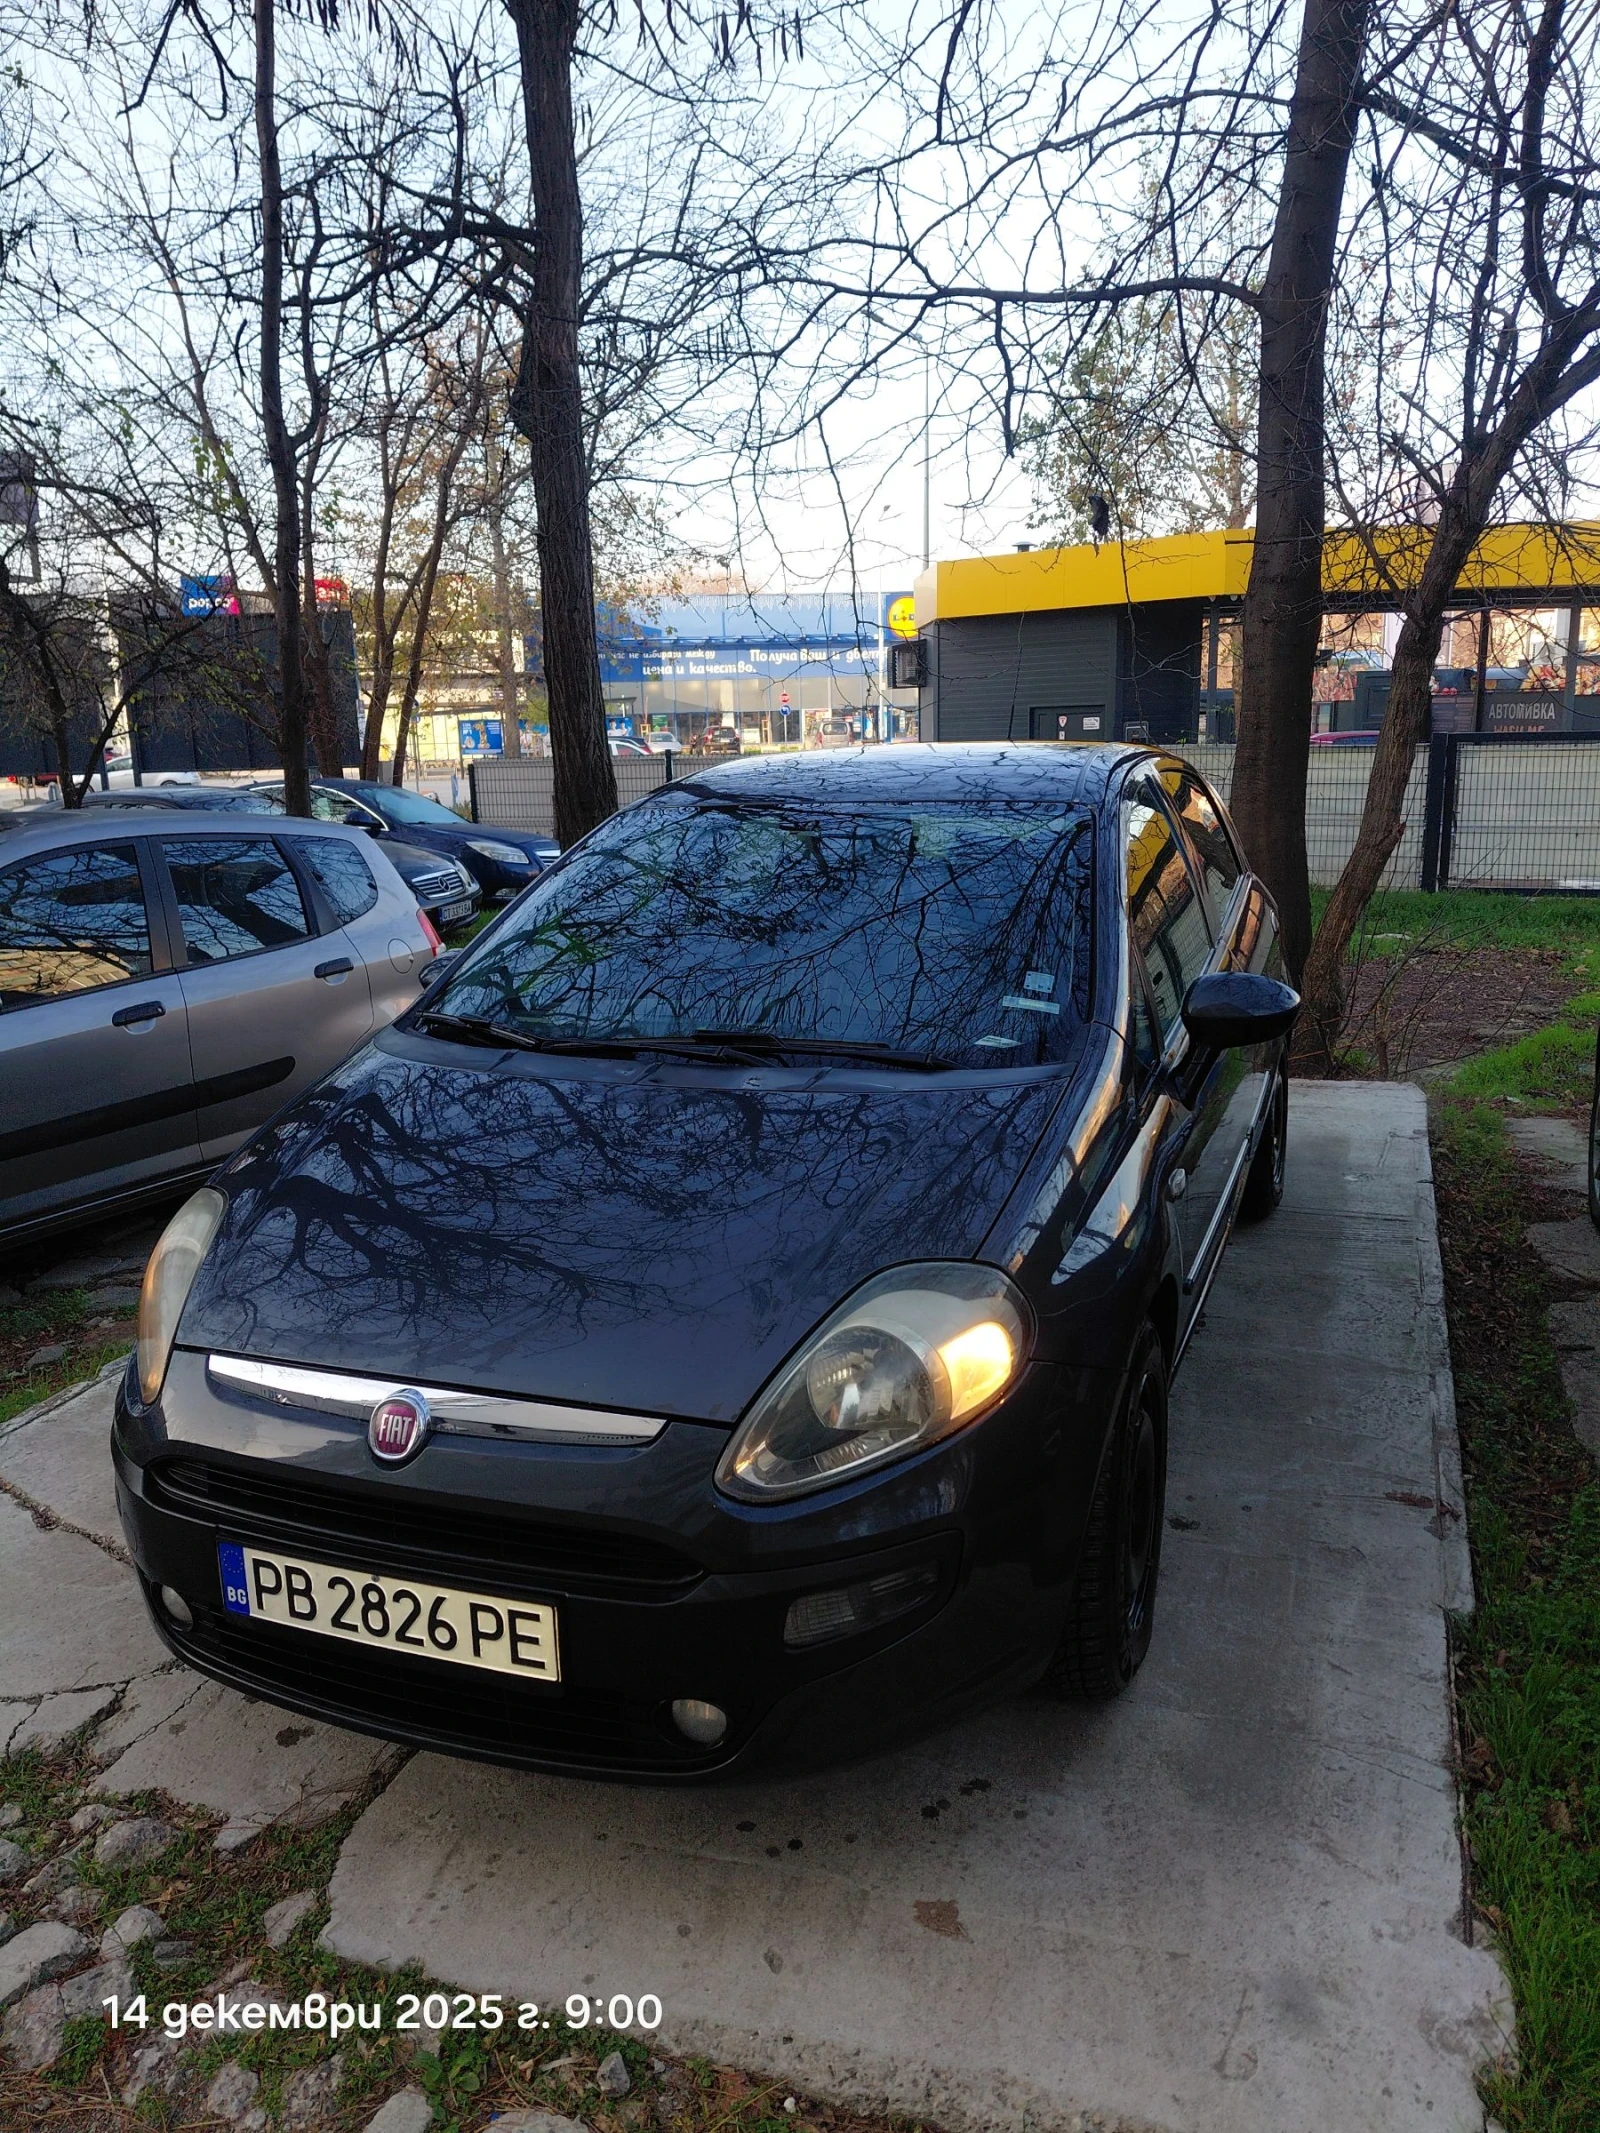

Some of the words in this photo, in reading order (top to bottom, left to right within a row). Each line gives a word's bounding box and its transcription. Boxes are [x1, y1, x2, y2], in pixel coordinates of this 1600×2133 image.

[676, 665, 685, 675] и
[689, 661, 757, 675] качество.
[1488, 702, 1556, 720] АВТОМИВКА
[378, 1413, 413, 1445] FIAT
[226, 1586, 247, 1604] BG
[252, 1557, 317, 1622] PB
[327, 1576, 458, 1651] 2826
[469, 1601, 547, 1669] PE
